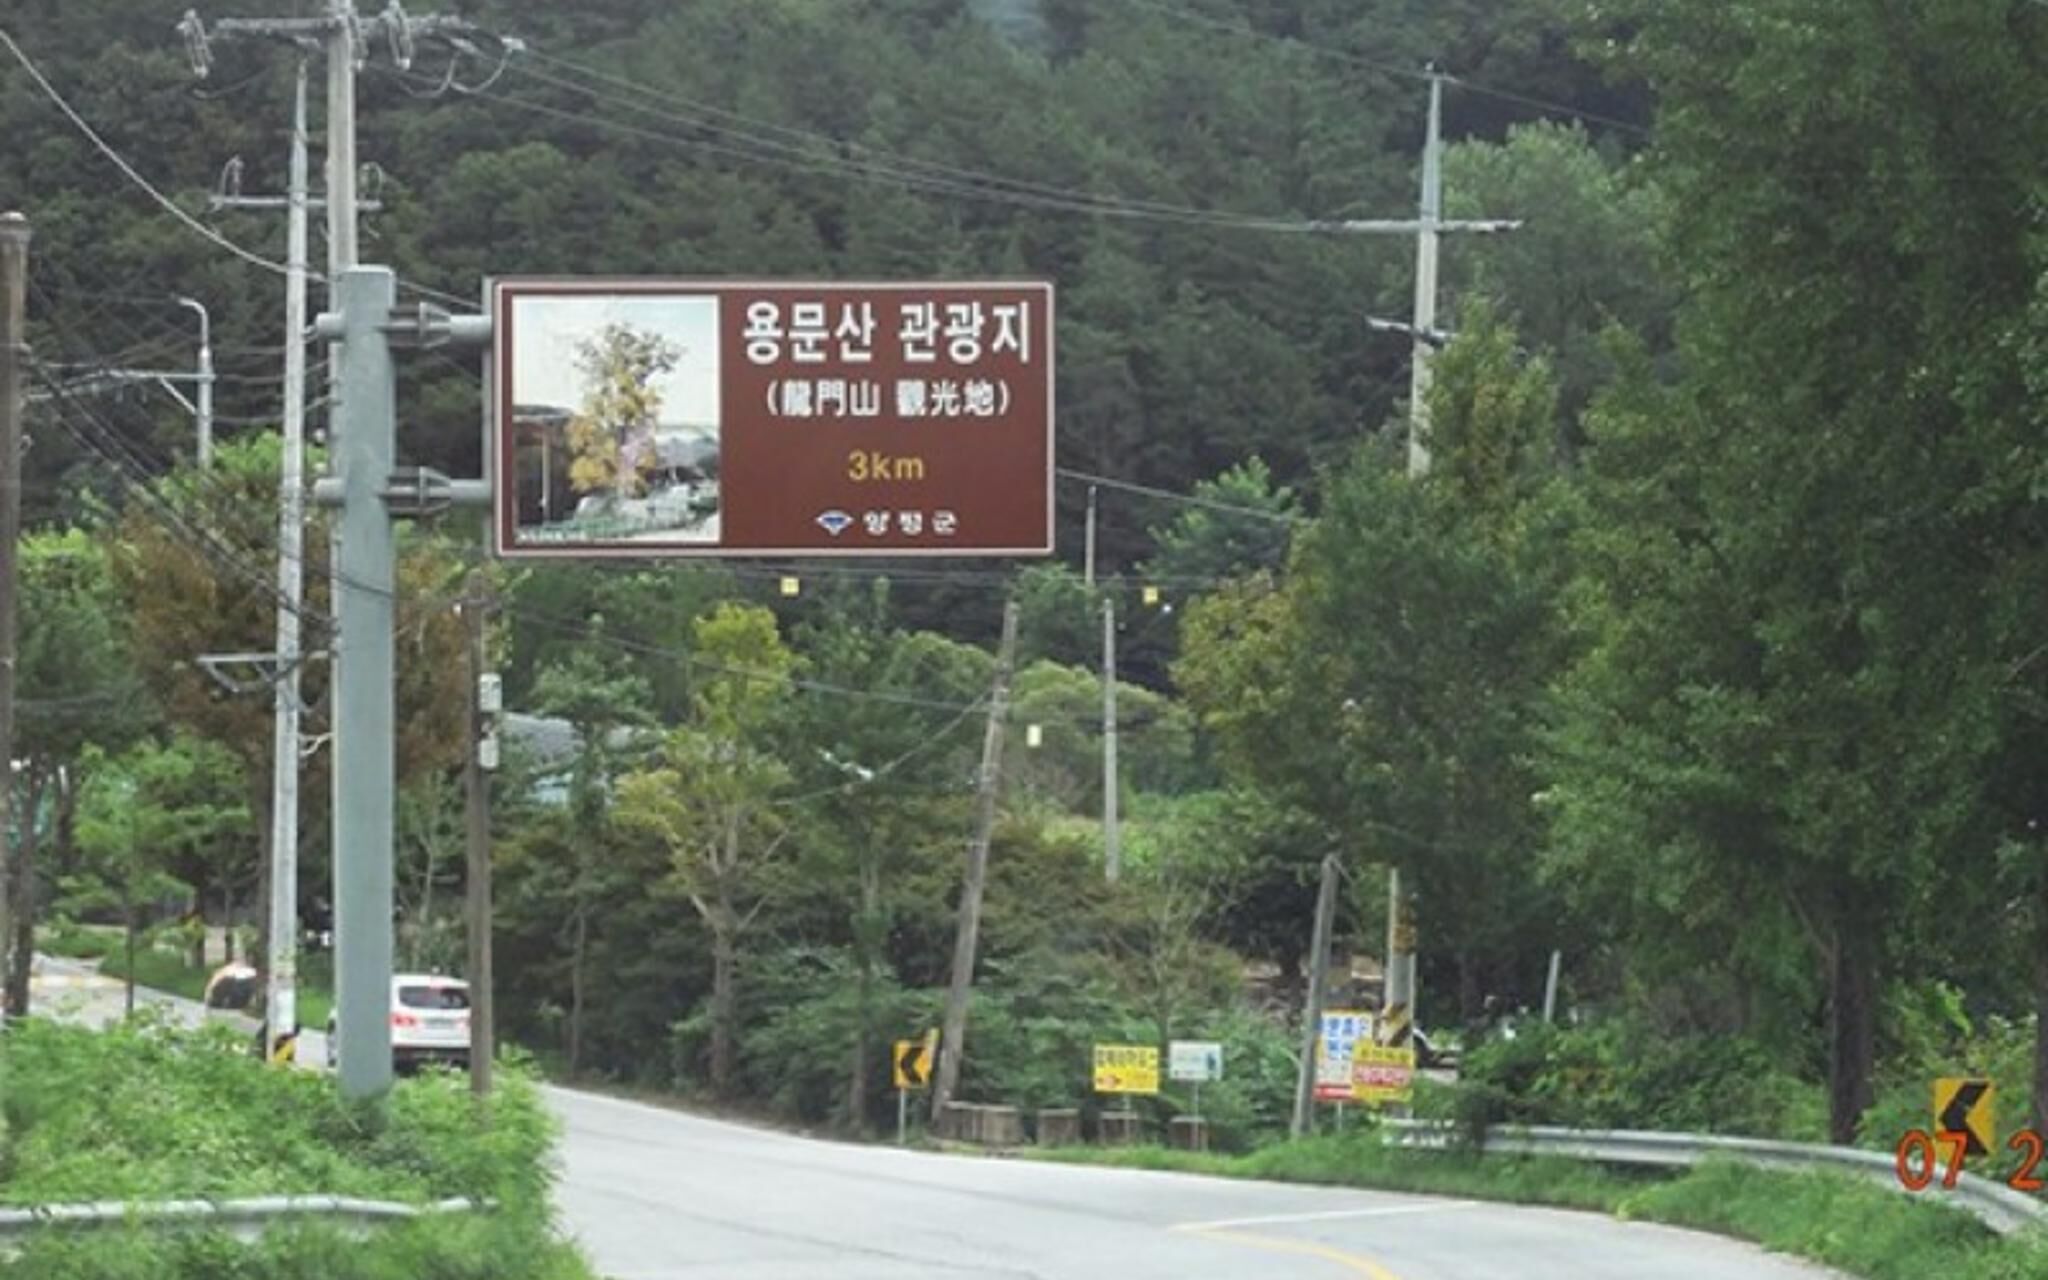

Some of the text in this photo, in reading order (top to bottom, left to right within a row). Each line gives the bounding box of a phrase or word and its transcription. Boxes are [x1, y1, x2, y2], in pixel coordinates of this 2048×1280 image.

[743, 301, 1029, 364] 용문산 관광지
[848, 450, 924, 480] 3km
